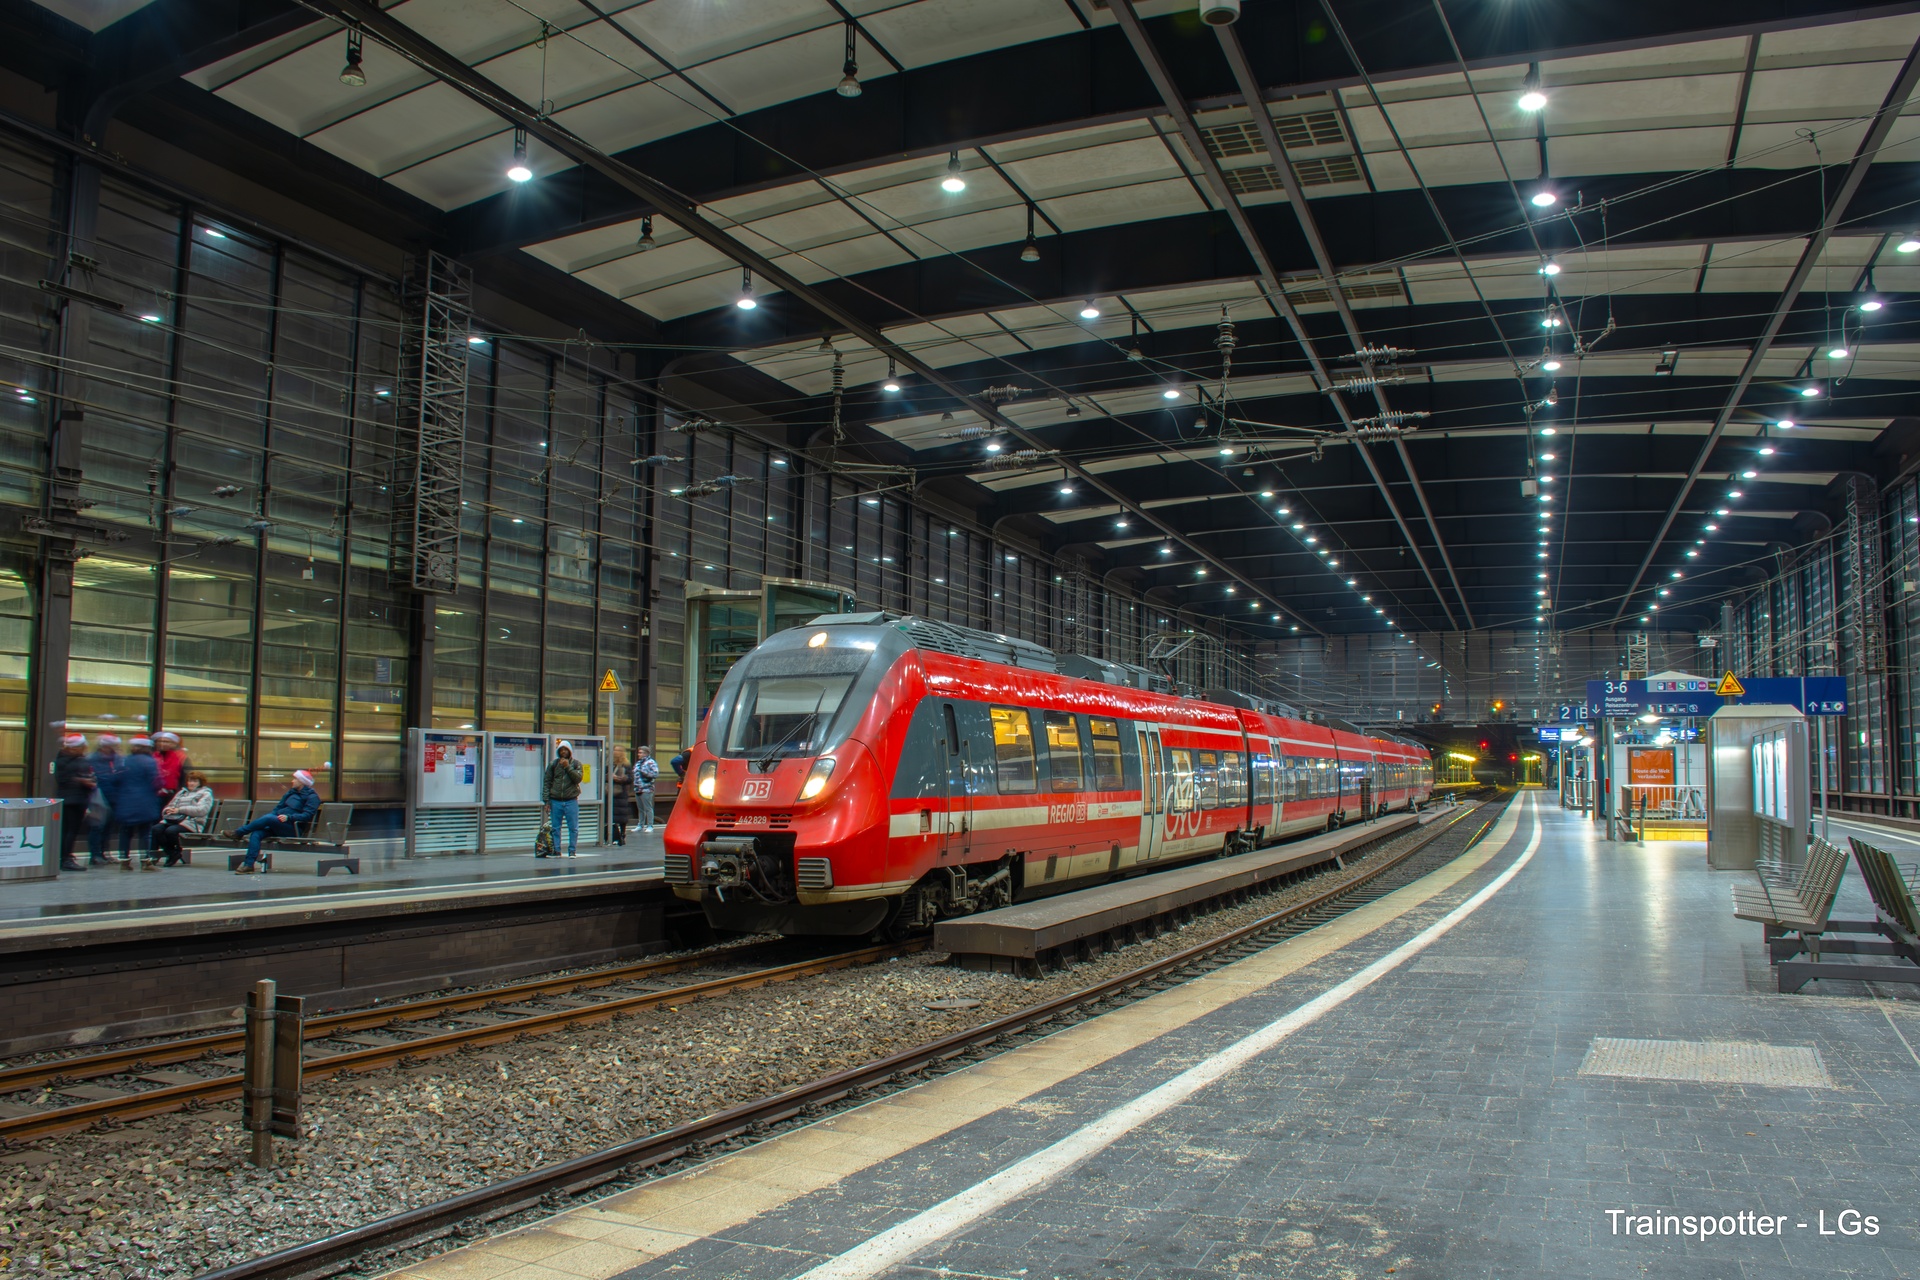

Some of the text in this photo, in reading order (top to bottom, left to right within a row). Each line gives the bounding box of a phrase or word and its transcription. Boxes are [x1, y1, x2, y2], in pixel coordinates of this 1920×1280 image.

[1605, 681, 1628, 694] 3-6
[1688, 681, 1697, 690] U
[1561, 706, 1570, 719] 2
[742, 780, 772, 799] DB
[1050, 803, 1075, 824] REGIO
